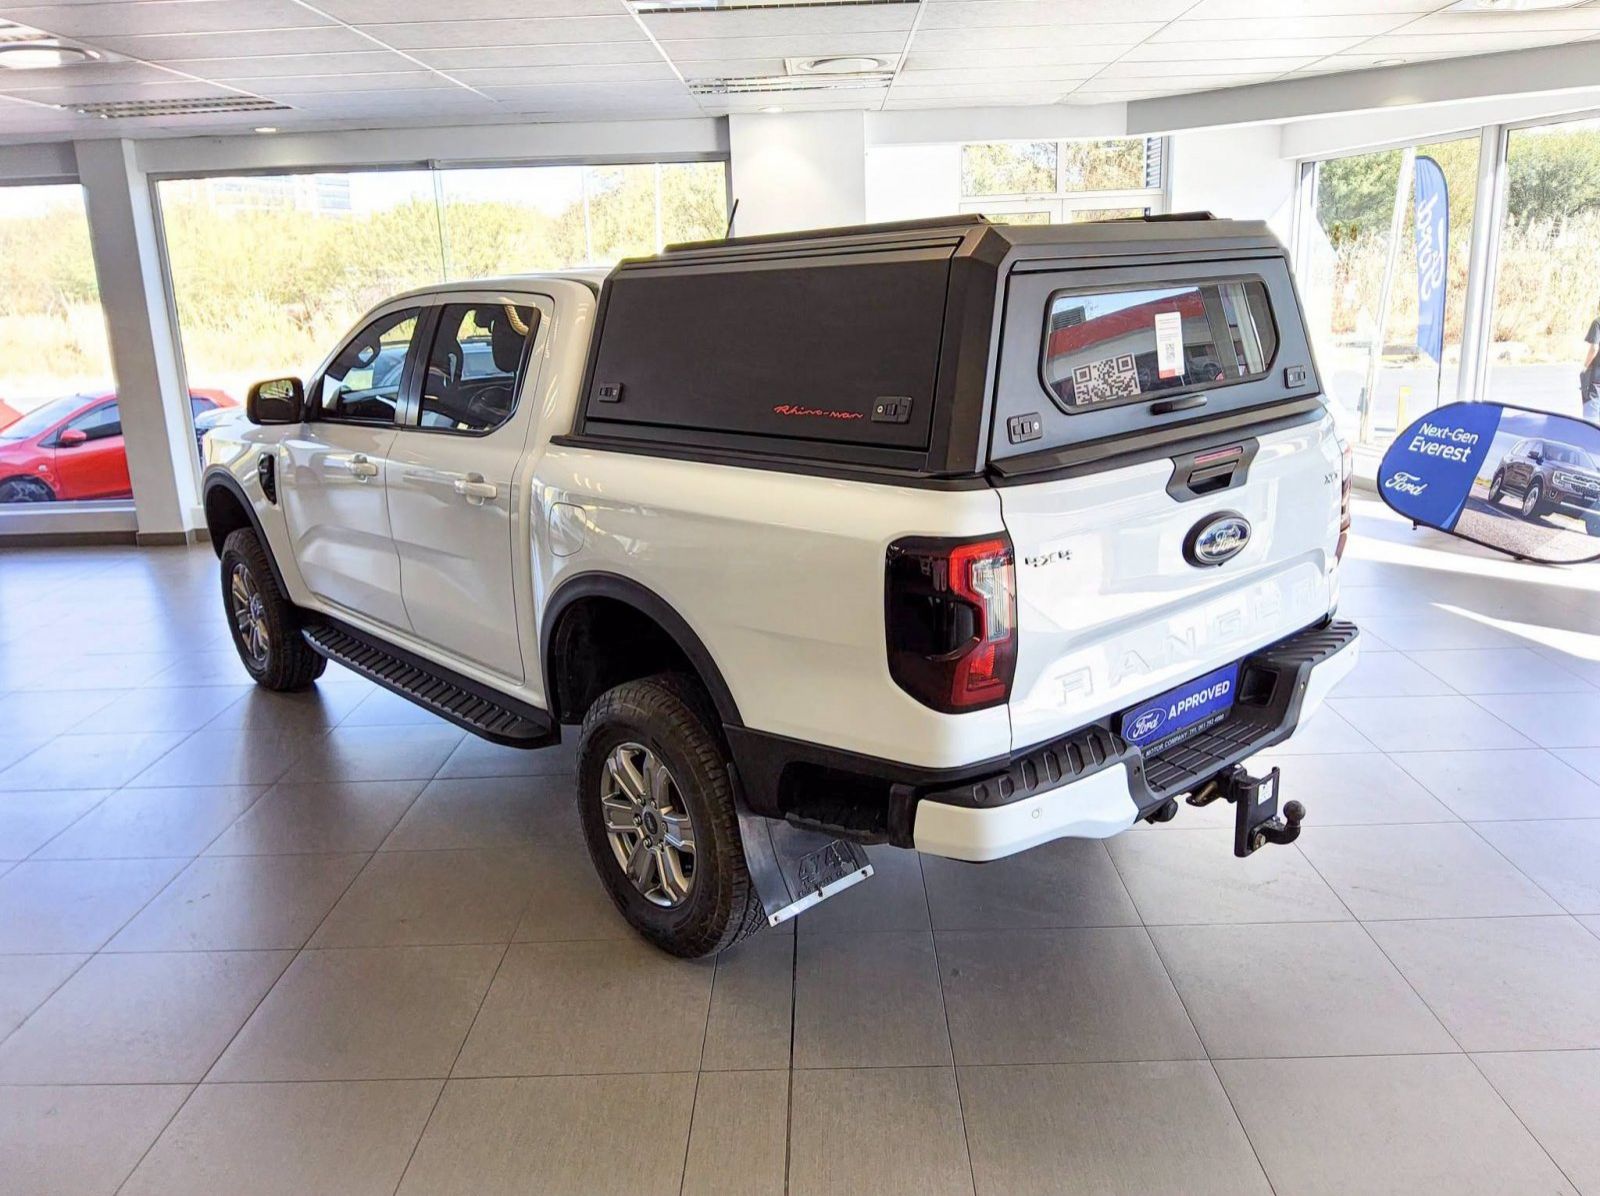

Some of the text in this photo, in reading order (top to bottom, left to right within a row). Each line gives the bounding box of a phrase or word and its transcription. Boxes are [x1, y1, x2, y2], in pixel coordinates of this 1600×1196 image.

[773, 404, 864, 419] Rhino-man
[1419, 422, 1479, 445] Next-Gen
[1408, 435, 1472, 463] Everest
[1385, 471, 1428, 496] Ford
[1132, 680, 1231, 738] Ford APPROVED
[1145, 743, 1164, 756] MOTOR
[1164, 732, 1188, 749] COMPANY
